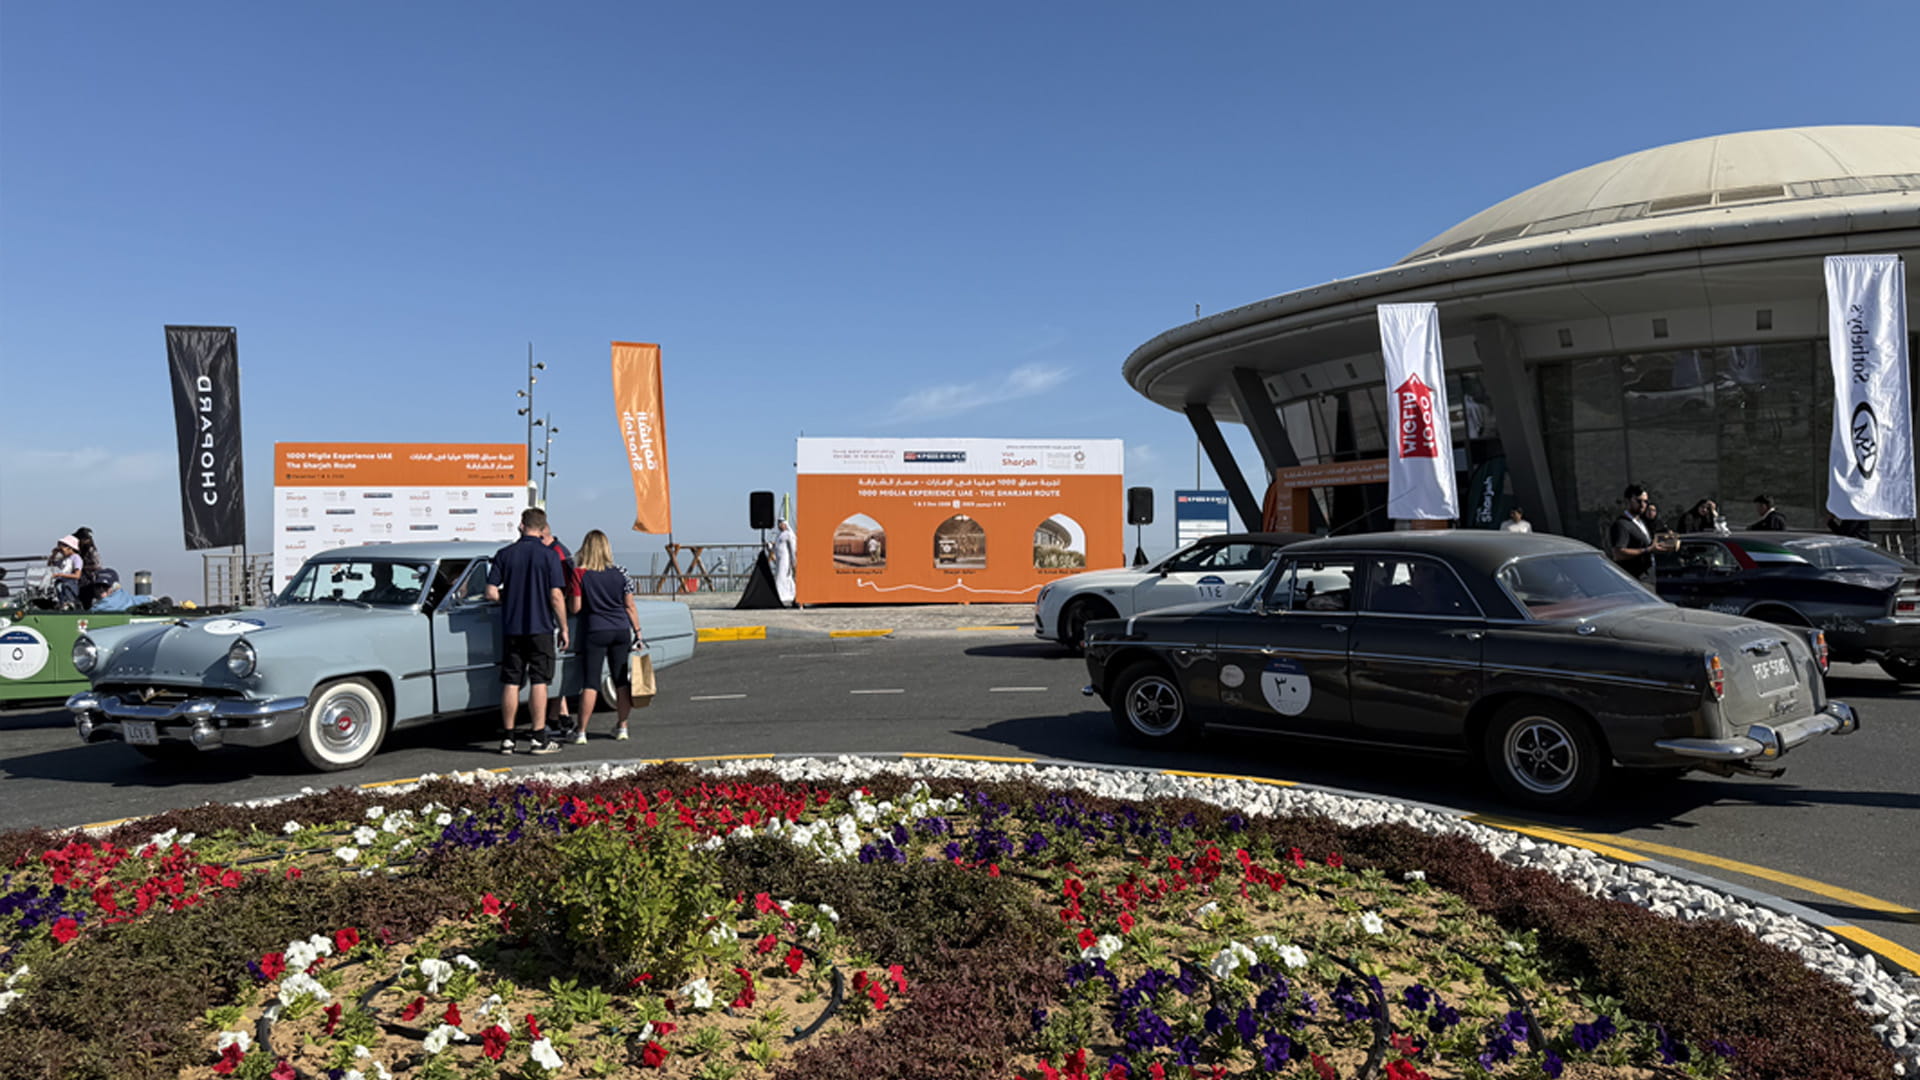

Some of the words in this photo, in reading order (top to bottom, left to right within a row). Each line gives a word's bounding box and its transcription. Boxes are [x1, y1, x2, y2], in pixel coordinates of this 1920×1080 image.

[333, 452, 375, 461] Experience
[303, 462, 332, 470] Sharjah
[1002, 458, 1038, 468] Sharjah
